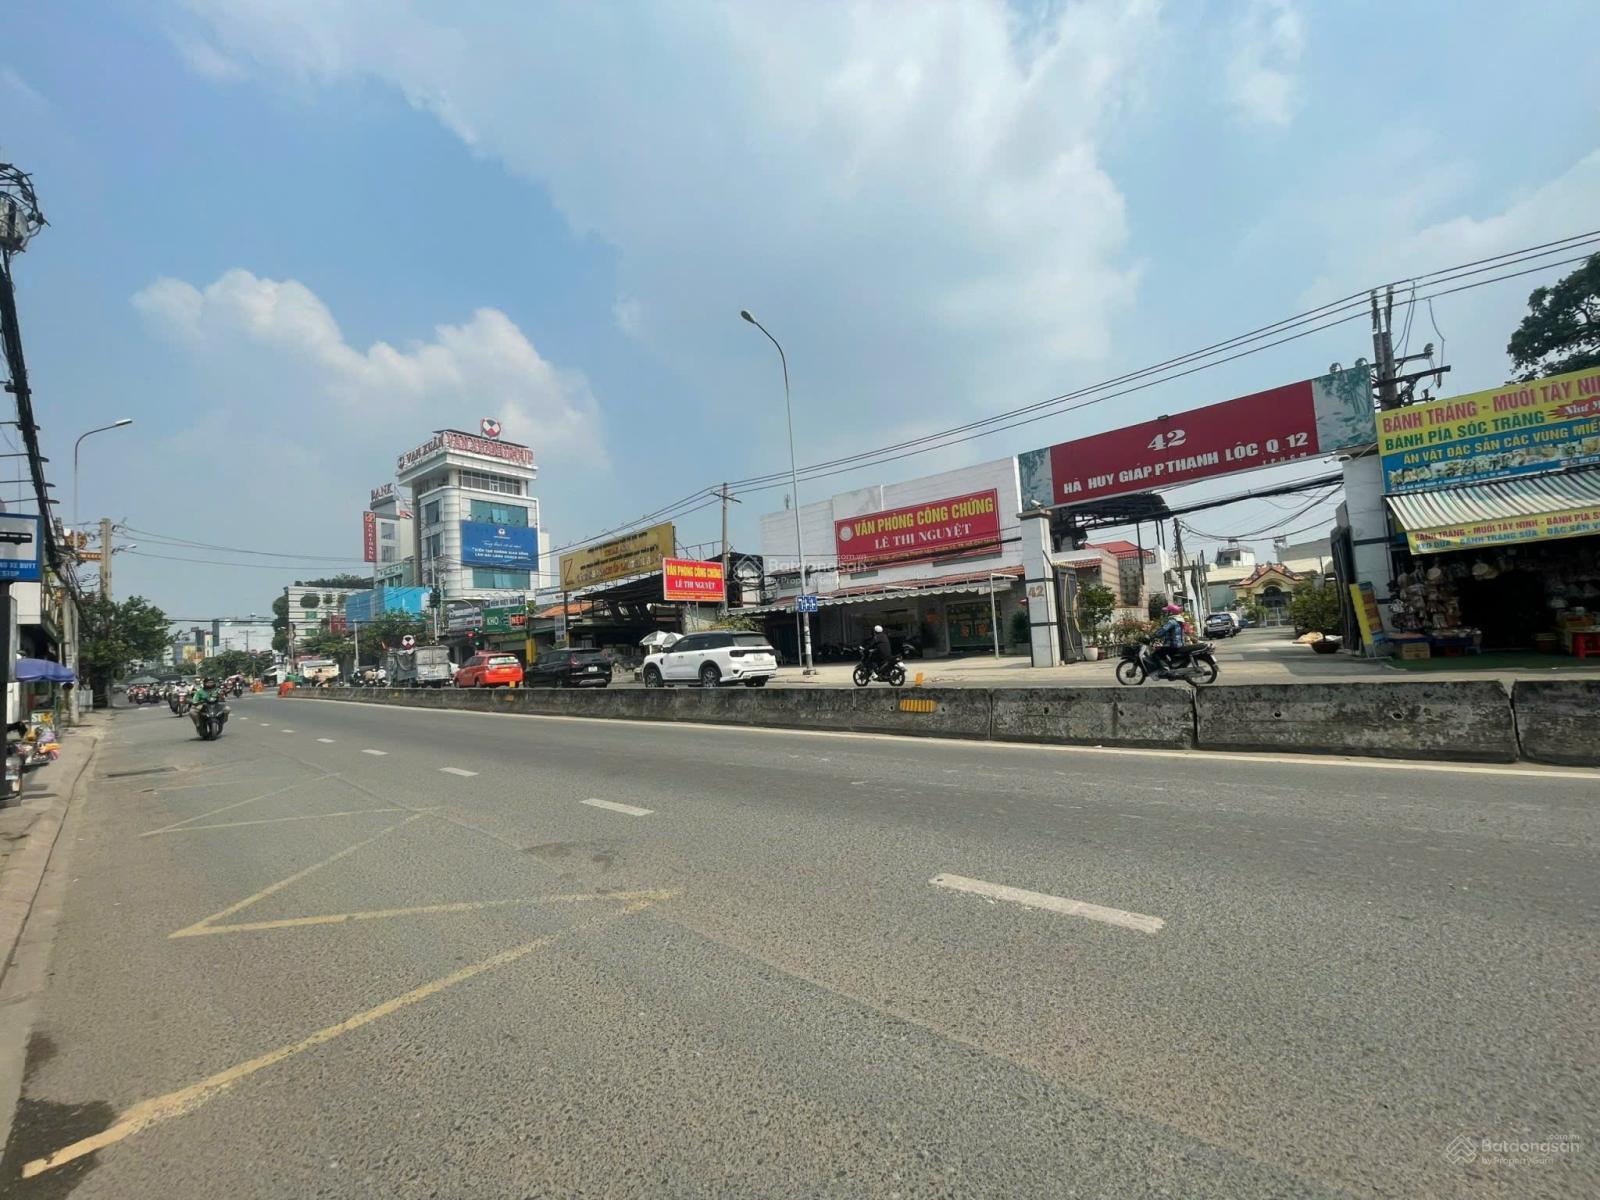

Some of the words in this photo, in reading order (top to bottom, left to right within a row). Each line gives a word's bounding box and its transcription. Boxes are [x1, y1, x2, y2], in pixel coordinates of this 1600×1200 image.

[1383, 413, 1423, 433] BÁNH
[1426, 401, 1477, 424] TRÁNG
[1493, 384, 1536, 412] MUỐI
[1541, 380, 1572, 403] TÂY
[1147, 429, 1186, 450] 42
[1385, 432, 1424, 450] BÁNH
[1428, 427, 1452, 442] PÍA
[1457, 420, 1488, 438] SÓC
[1491, 411, 1544, 431] TRĂNG
[1504, 434, 1528, 448] CÁC
[1063, 477, 1082, 494] HÀ
[1087, 473, 1114, 489] HUY
[1119, 463, 1152, 483] GIÁP
[1226, 442, 1258, 462] LỘC
[1286, 432, 1308, 448] 12
[854, 520, 875, 536] VĂN
[878, 512, 914, 532] PHÒNG
[917, 506, 948, 524] CÔNG
[952, 498, 993, 519] CHỨNG
[875, 537, 890, 549] LÊ
[892, 533, 914, 546] THỊ
[919, 523, 972, 541] NGUYỆT
[1028, 585, 1044, 598] 42
